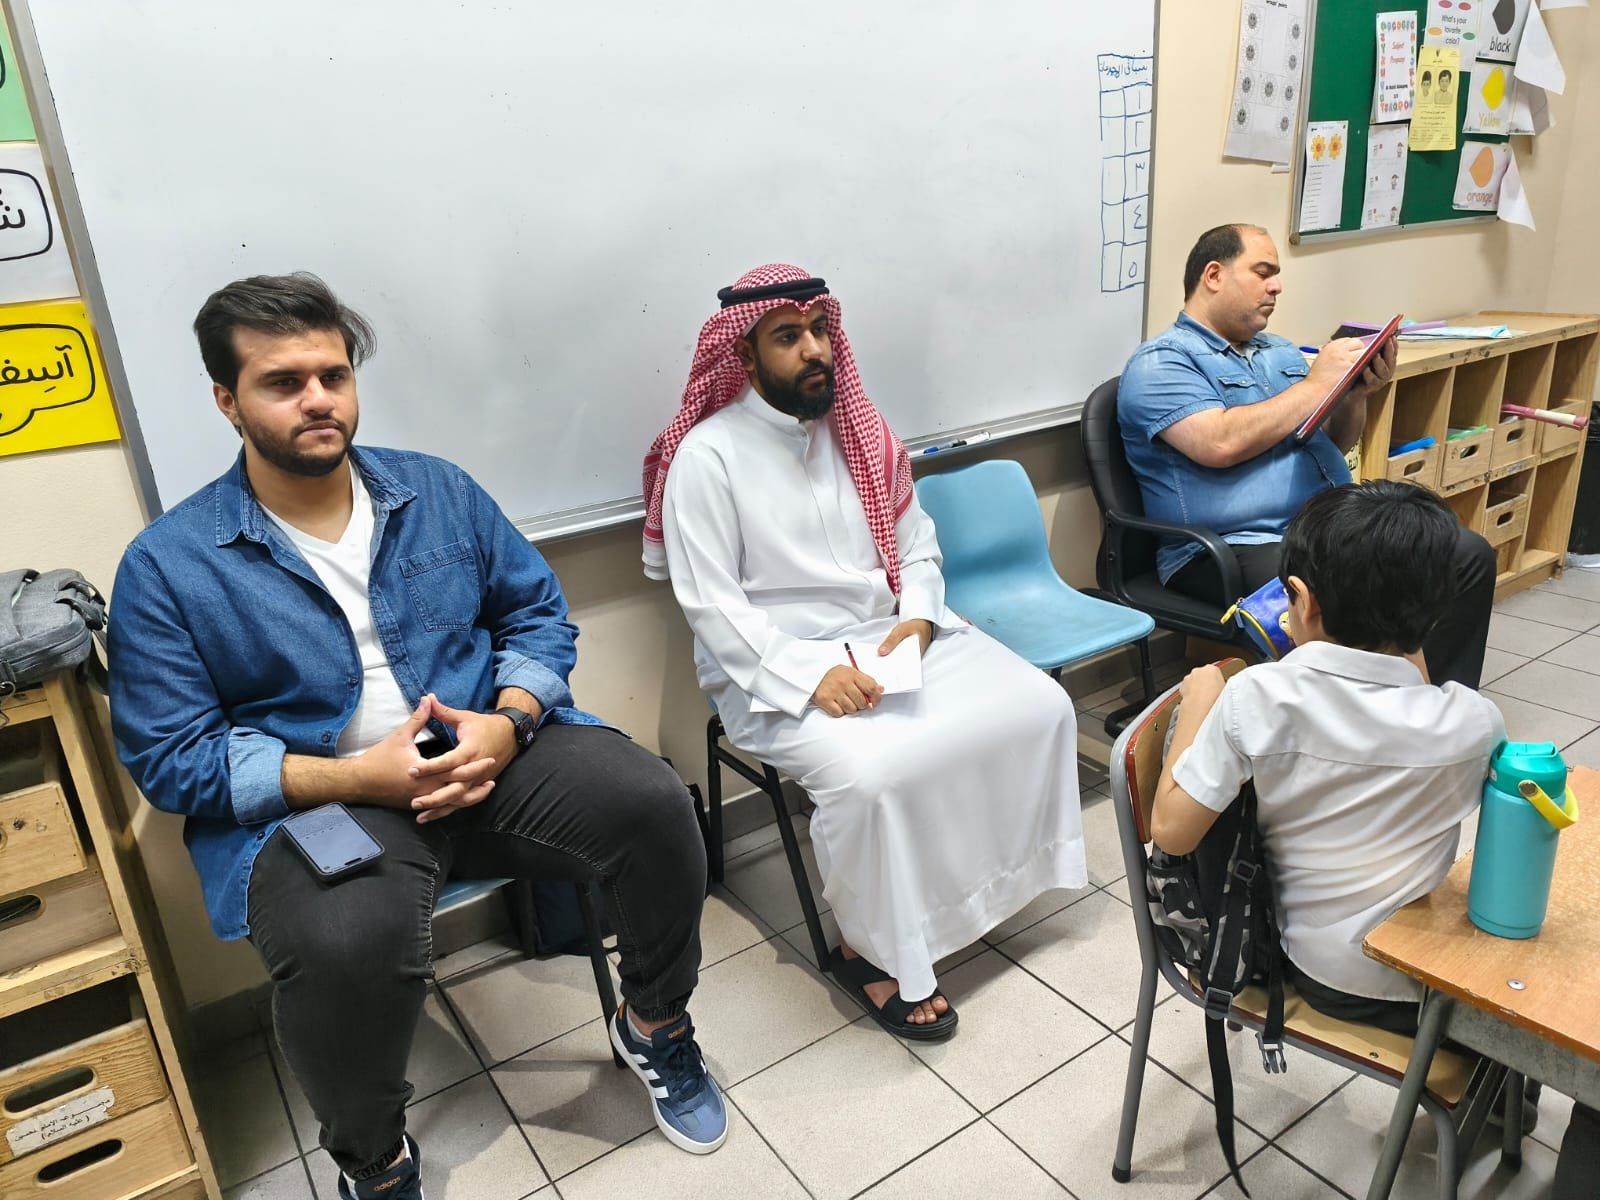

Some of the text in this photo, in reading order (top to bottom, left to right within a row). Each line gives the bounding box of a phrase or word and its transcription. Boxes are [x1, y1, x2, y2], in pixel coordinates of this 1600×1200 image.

[1489, 36, 1511, 53] black
[1466, 191, 1494, 207] orange
[373, 1175, 401, 1192] adidas
